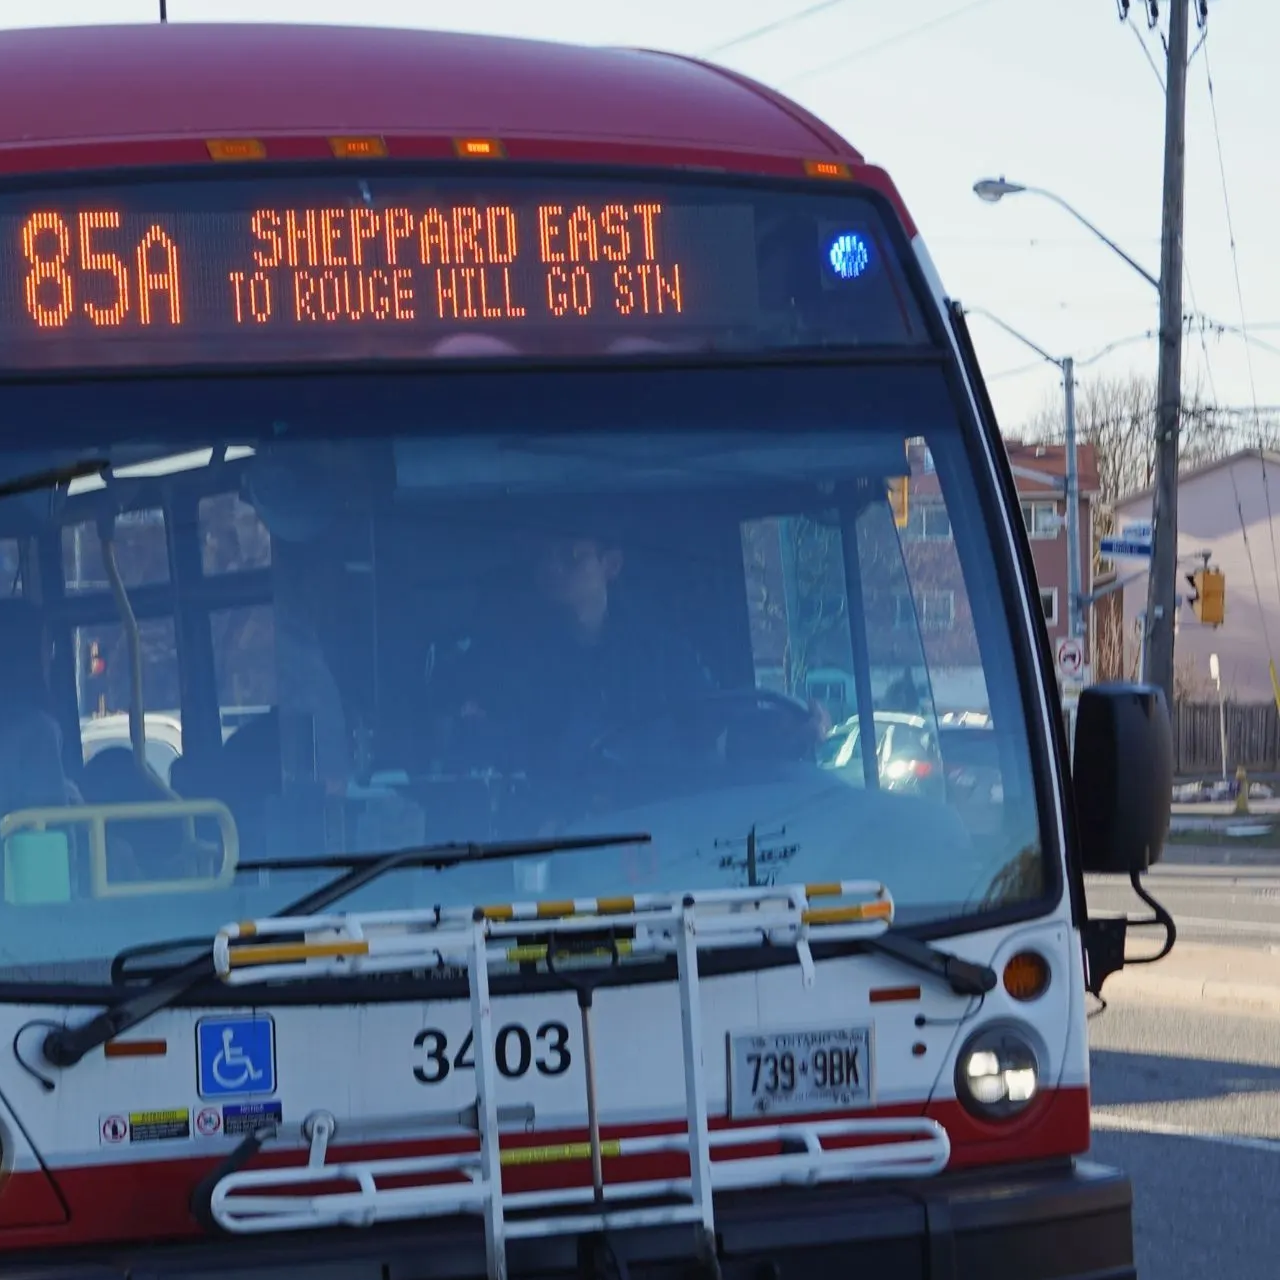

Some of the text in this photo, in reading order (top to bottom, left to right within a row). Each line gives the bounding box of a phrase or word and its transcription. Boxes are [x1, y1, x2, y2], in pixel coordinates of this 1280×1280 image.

[252, 204, 661, 267] SHEPPARD EAST
[23, 212, 181, 326] 85A
[230, 264, 681, 322] TO ROUGE HILL GO STN
[413, 1021, 572, 1084] 3403
[746, 1045, 860, 1096] 739 9BK
